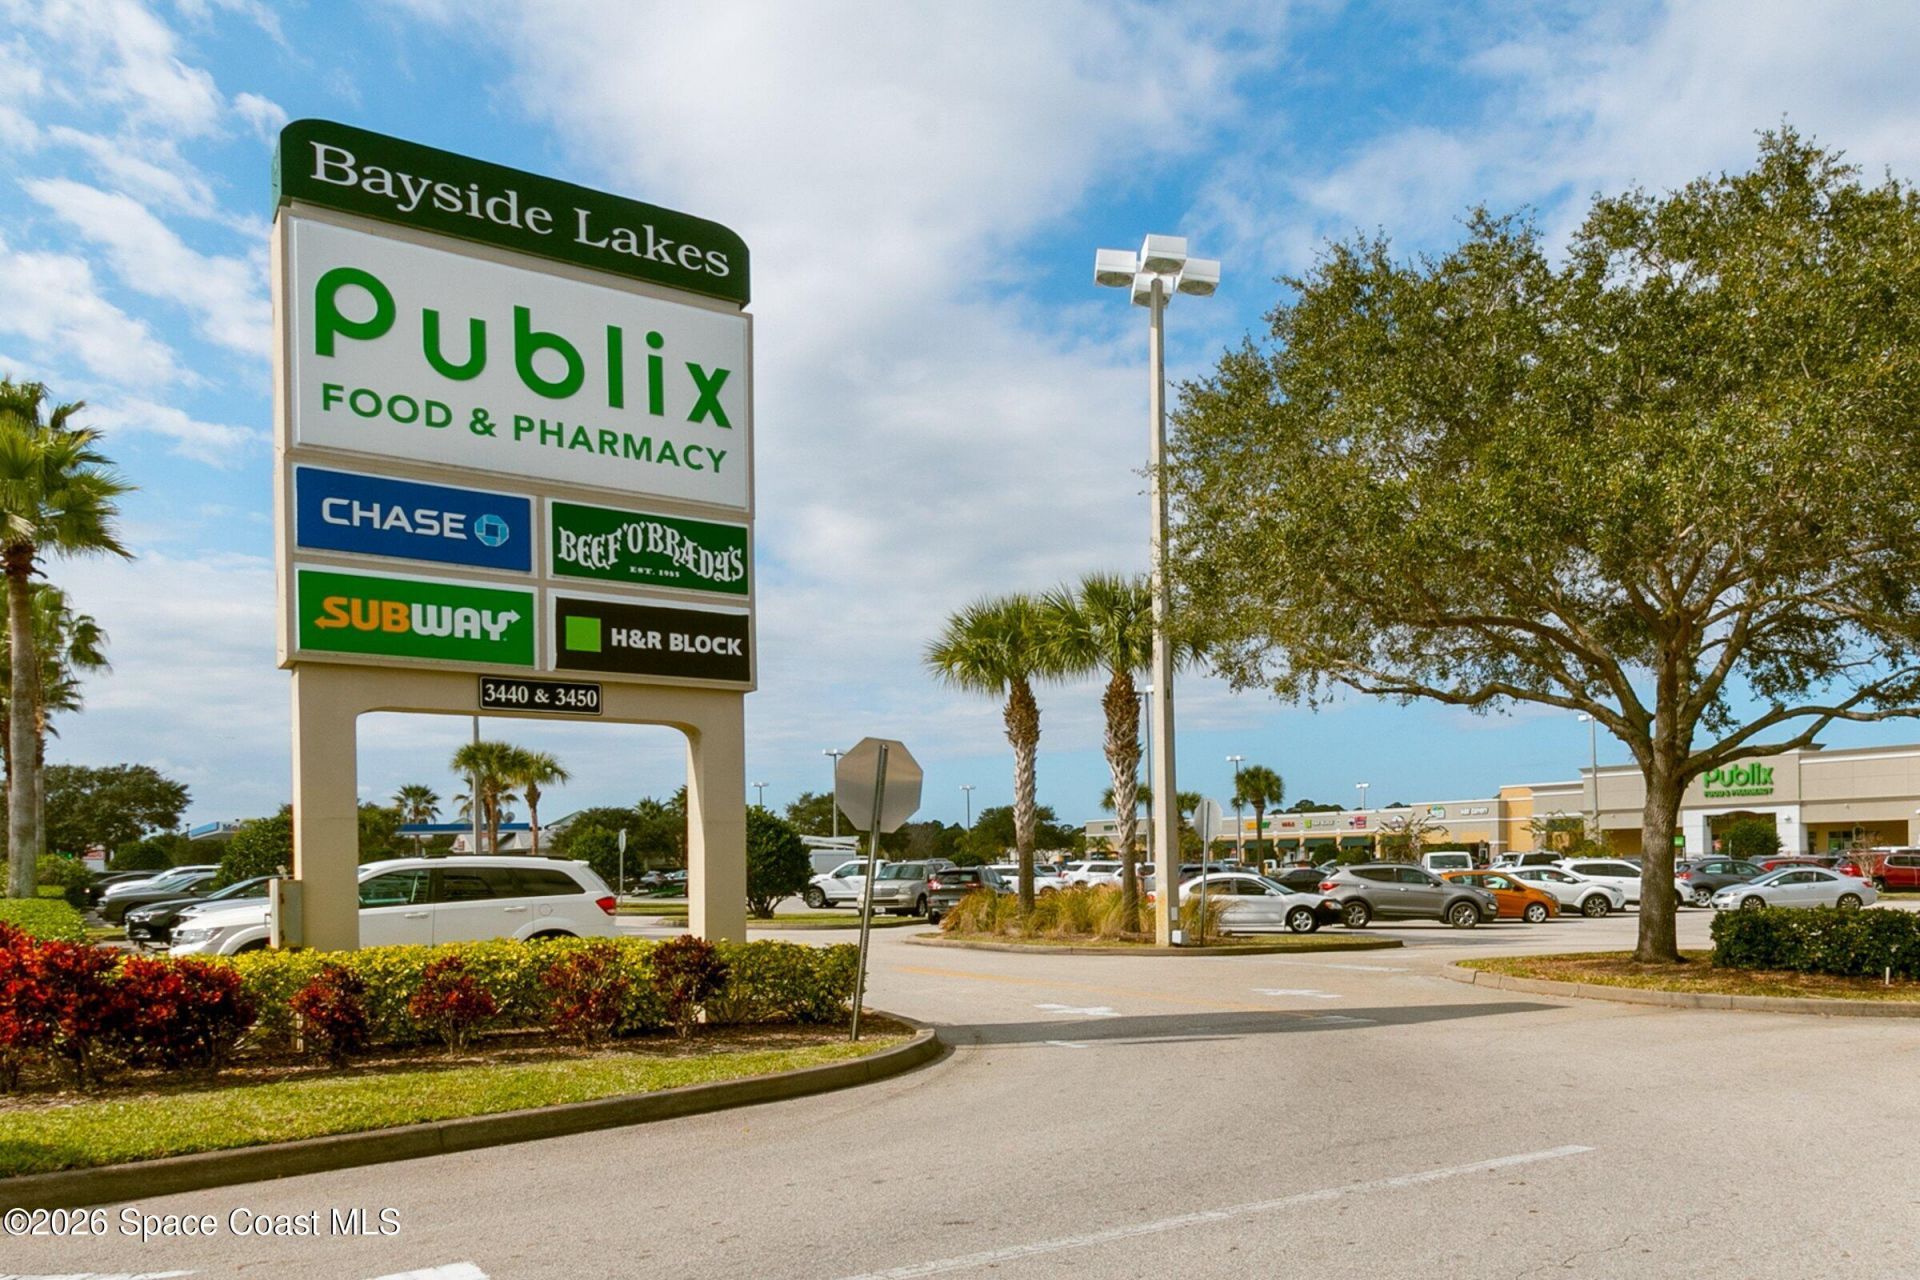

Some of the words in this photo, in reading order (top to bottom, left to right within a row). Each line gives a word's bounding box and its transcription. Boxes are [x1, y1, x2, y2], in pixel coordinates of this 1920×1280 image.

[309, 140, 554, 235] Bayside
[573, 207, 731, 278] Lakes
[314, 266, 732, 429] Publix
[320, 382, 453, 429] FOOD
[468, 407, 497, 437] &
[512, 414, 728, 474] PHARMACY
[322, 497, 468, 540] CHASE
[315, 595, 521, 641] SUBWAY
[611, 627, 662, 650] H&R
[669, 632, 744, 656] BLOCK
[484, 683, 529, 704] 3440
[534, 688, 551, 704] &
[554, 688, 598, 708] 3450
[1703, 763, 1775, 789] Publix
